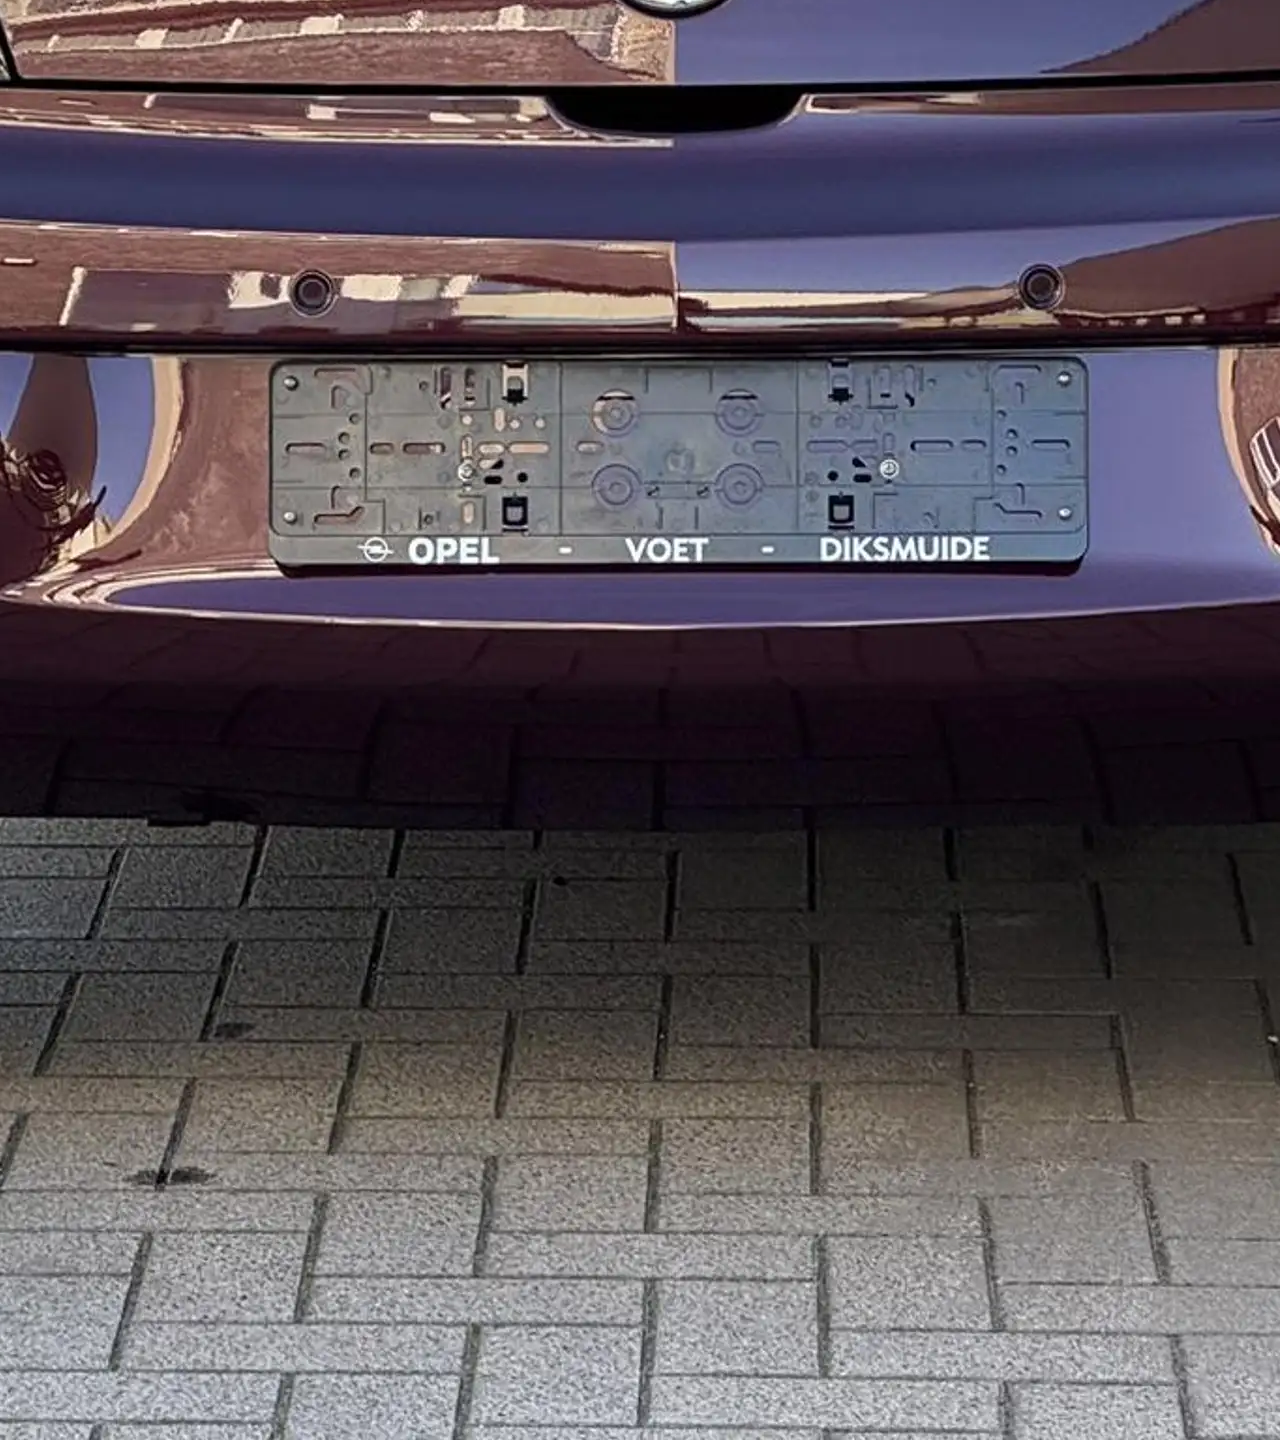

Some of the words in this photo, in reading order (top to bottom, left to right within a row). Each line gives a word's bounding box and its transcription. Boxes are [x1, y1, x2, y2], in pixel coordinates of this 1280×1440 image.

[407, 536, 501, 565] OPEL
[623, 536, 710, 563] VOET
[819, 535, 991, 562] DIKSMUIDE
